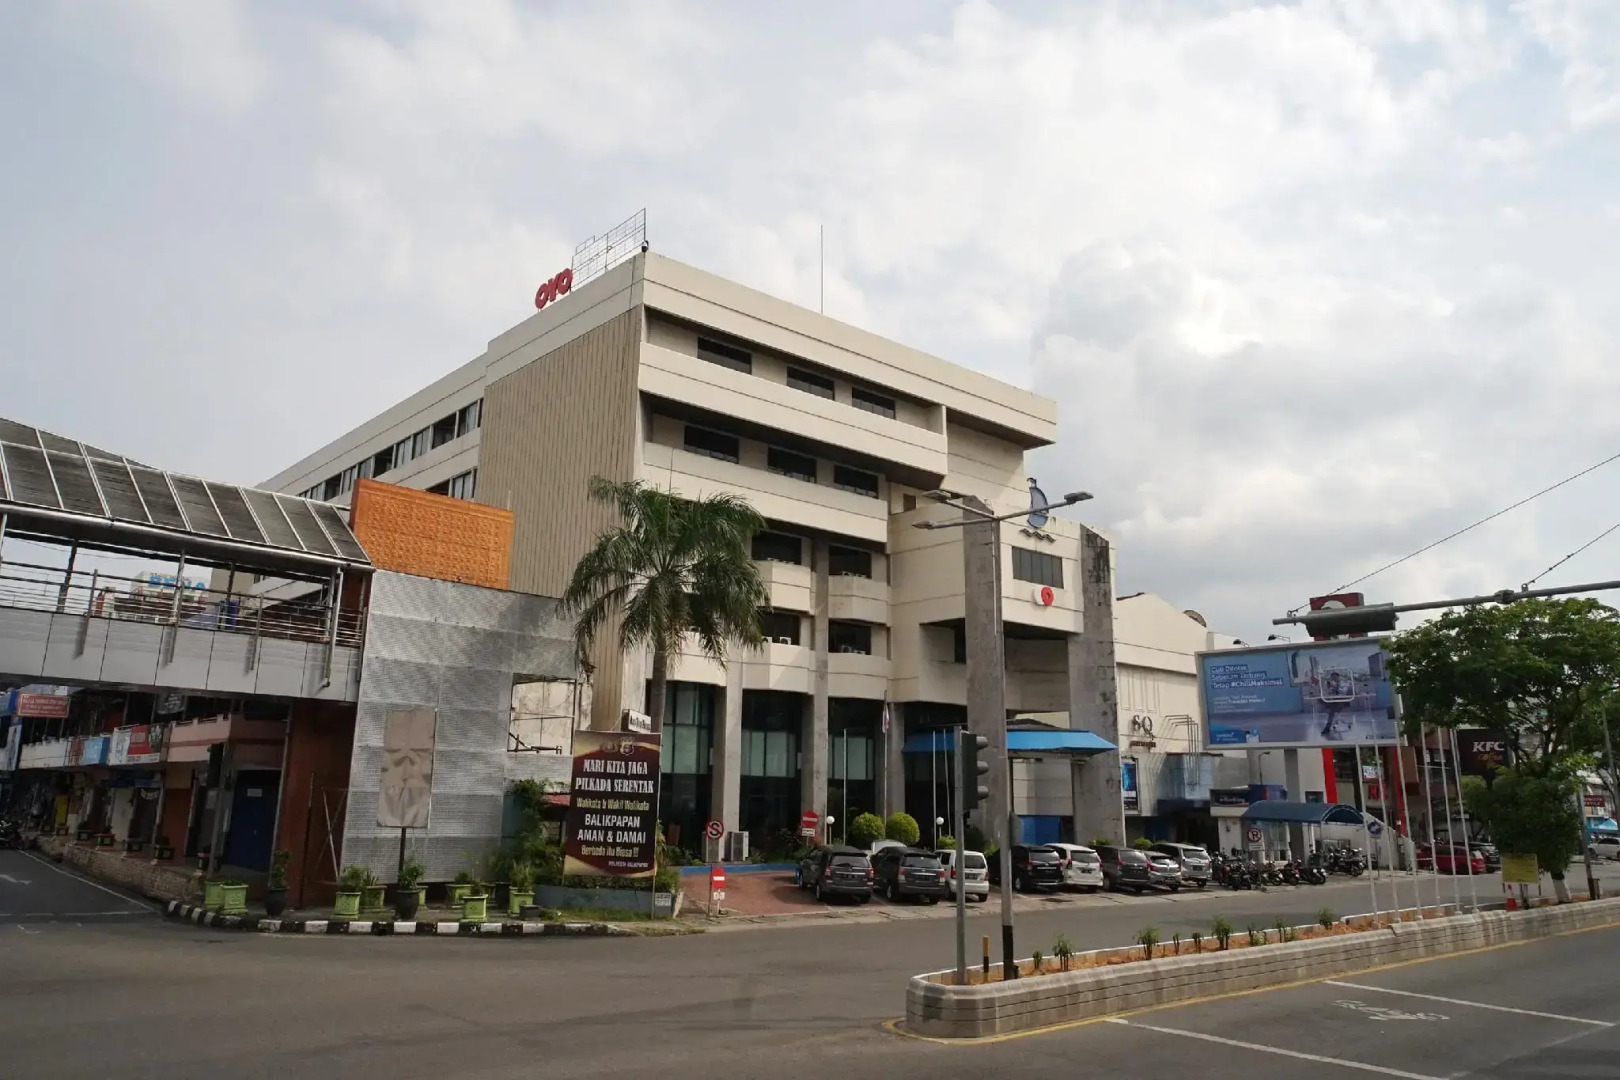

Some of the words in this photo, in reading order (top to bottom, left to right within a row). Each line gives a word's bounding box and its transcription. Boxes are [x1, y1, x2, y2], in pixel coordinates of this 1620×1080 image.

[535, 268, 573, 309] OYO
[1473, 742, 1505, 752] KFC
[583, 759, 605, 772] MARI
[606, 760, 625, 774] KITA
[627, 761, 648, 775] JAGA
[575, 777, 611, 791] PILKADA
[614, 779, 654, 793] SERENTAK
[607, 798, 624, 810] Wakil
[624, 799, 650, 811] Walikota
[585, 813, 641, 828] BALIKPAPAN
[577, 829, 605, 842] AMAN
[606, 831, 613, 843] &
[616, 831, 646, 844] DAMAI
[606, 846, 615, 857] itu
[616, 846, 633, 858] Biasa
